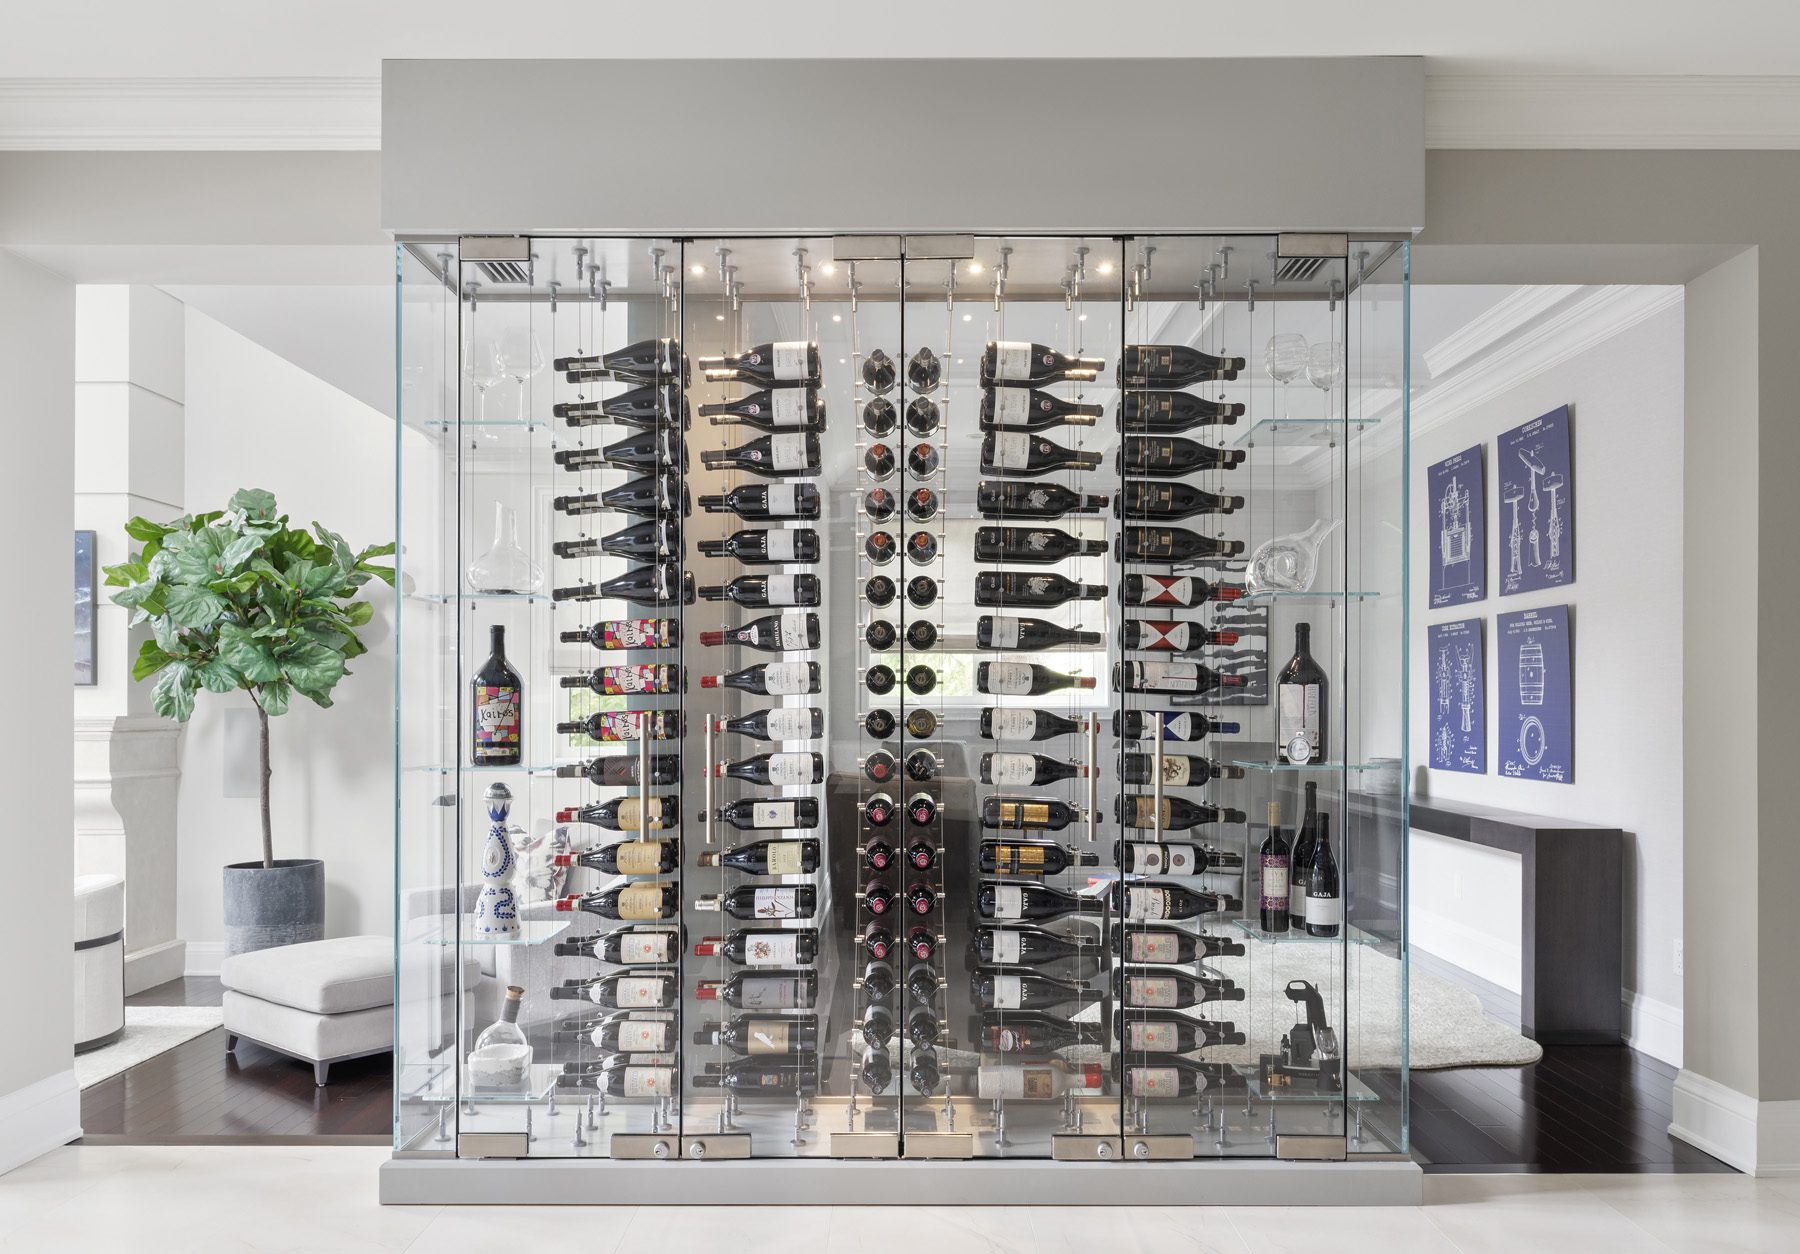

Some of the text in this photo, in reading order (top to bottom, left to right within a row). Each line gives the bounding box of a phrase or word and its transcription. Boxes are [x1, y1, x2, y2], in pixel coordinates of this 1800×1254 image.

[625, 620, 638, 645] Kairos
[625, 666, 638, 691] Kairos
[481, 709, 514, 723] Kairos
[621, 714, 633, 740] Kairos
